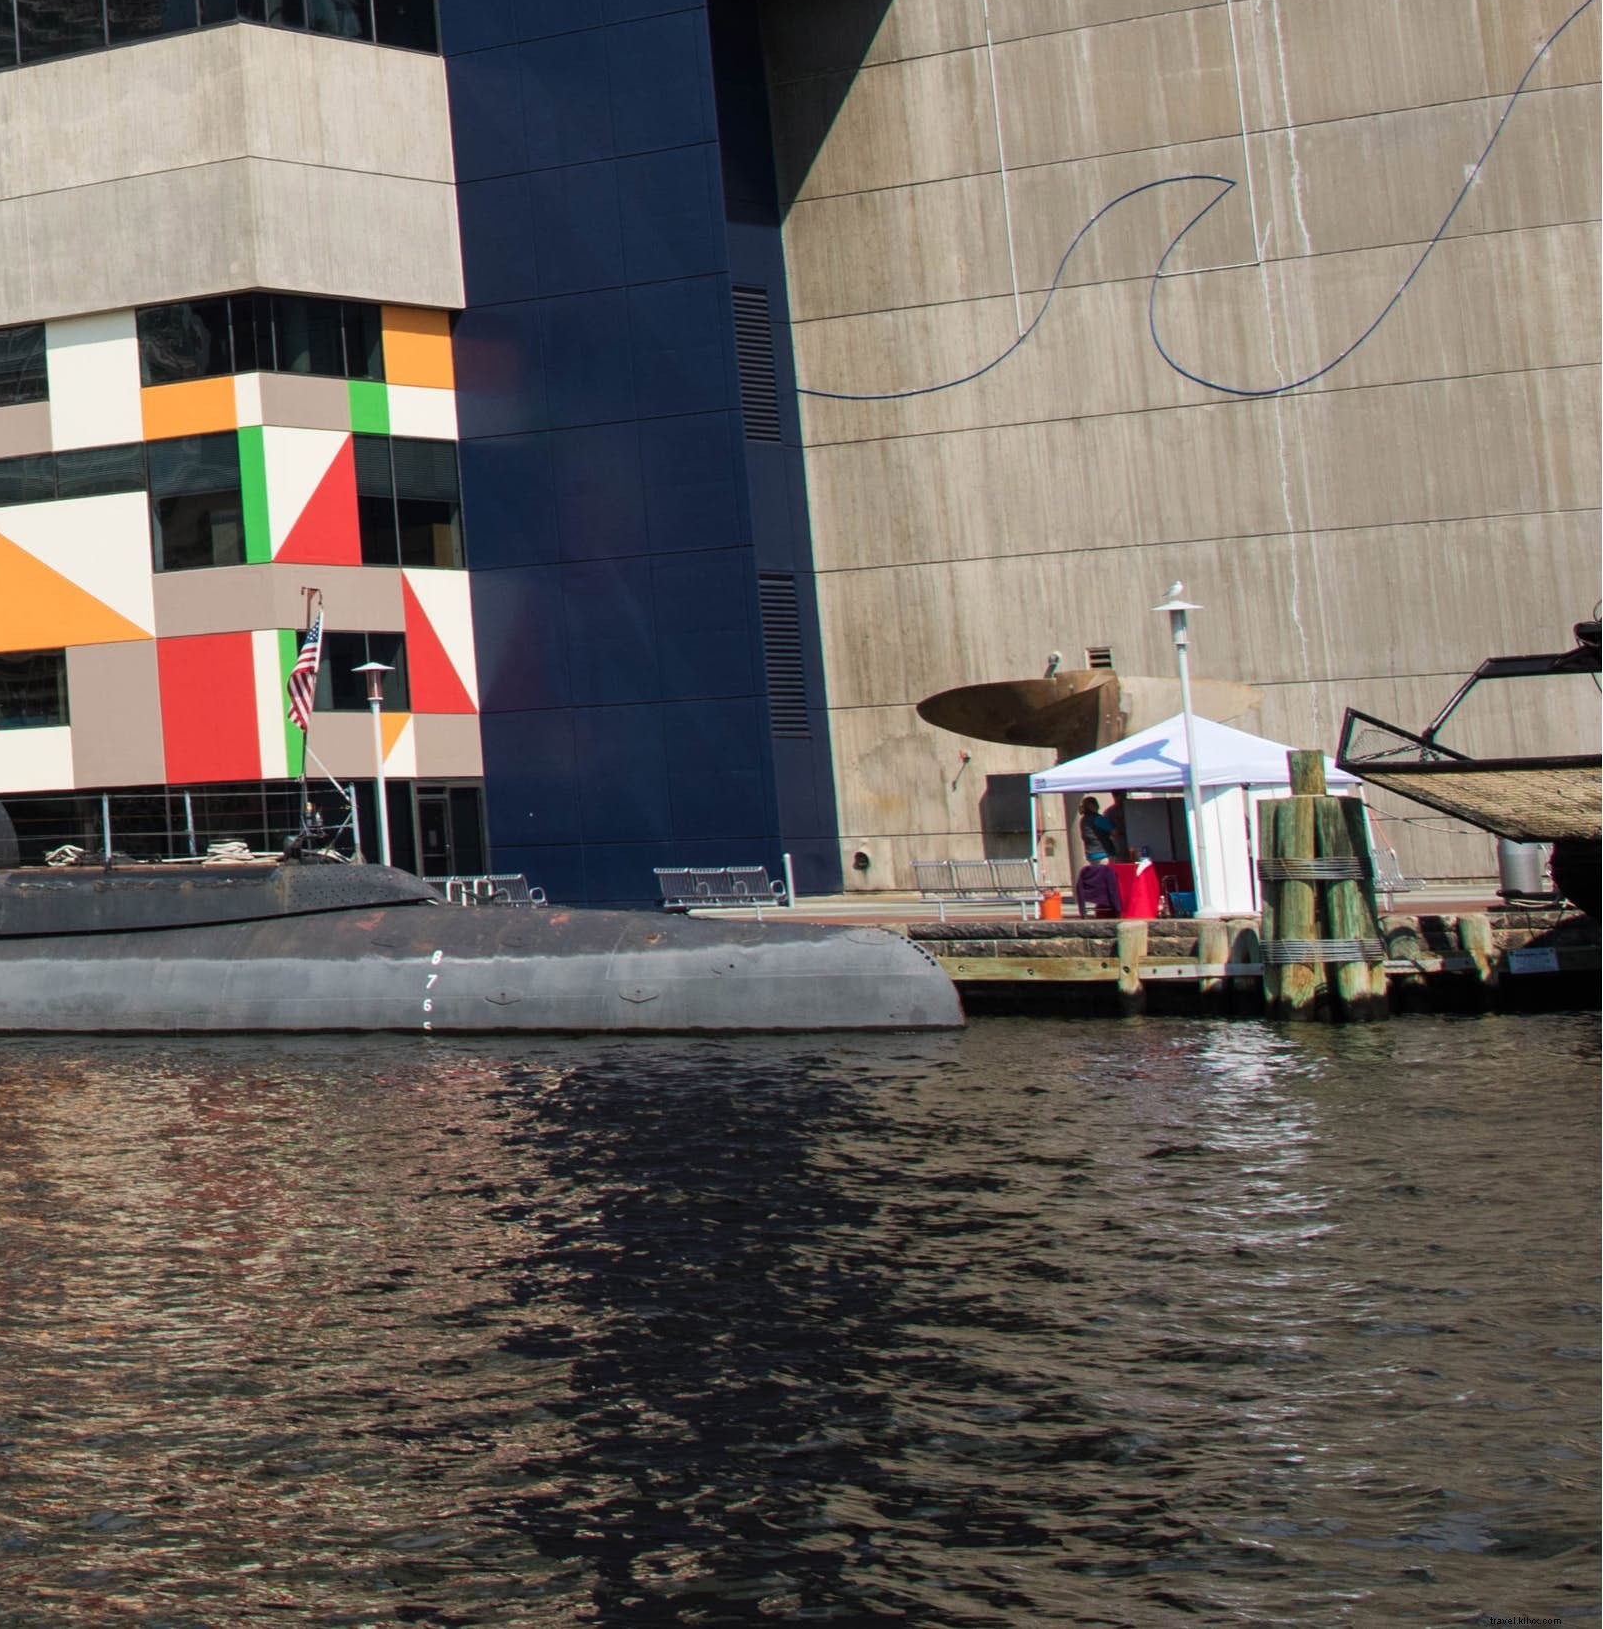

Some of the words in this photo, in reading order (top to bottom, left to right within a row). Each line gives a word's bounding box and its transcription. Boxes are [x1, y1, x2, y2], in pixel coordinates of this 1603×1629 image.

[431, 949, 443, 966] 8
[426, 974, 438, 989] 7
[422, 999, 433, 1012] 6
